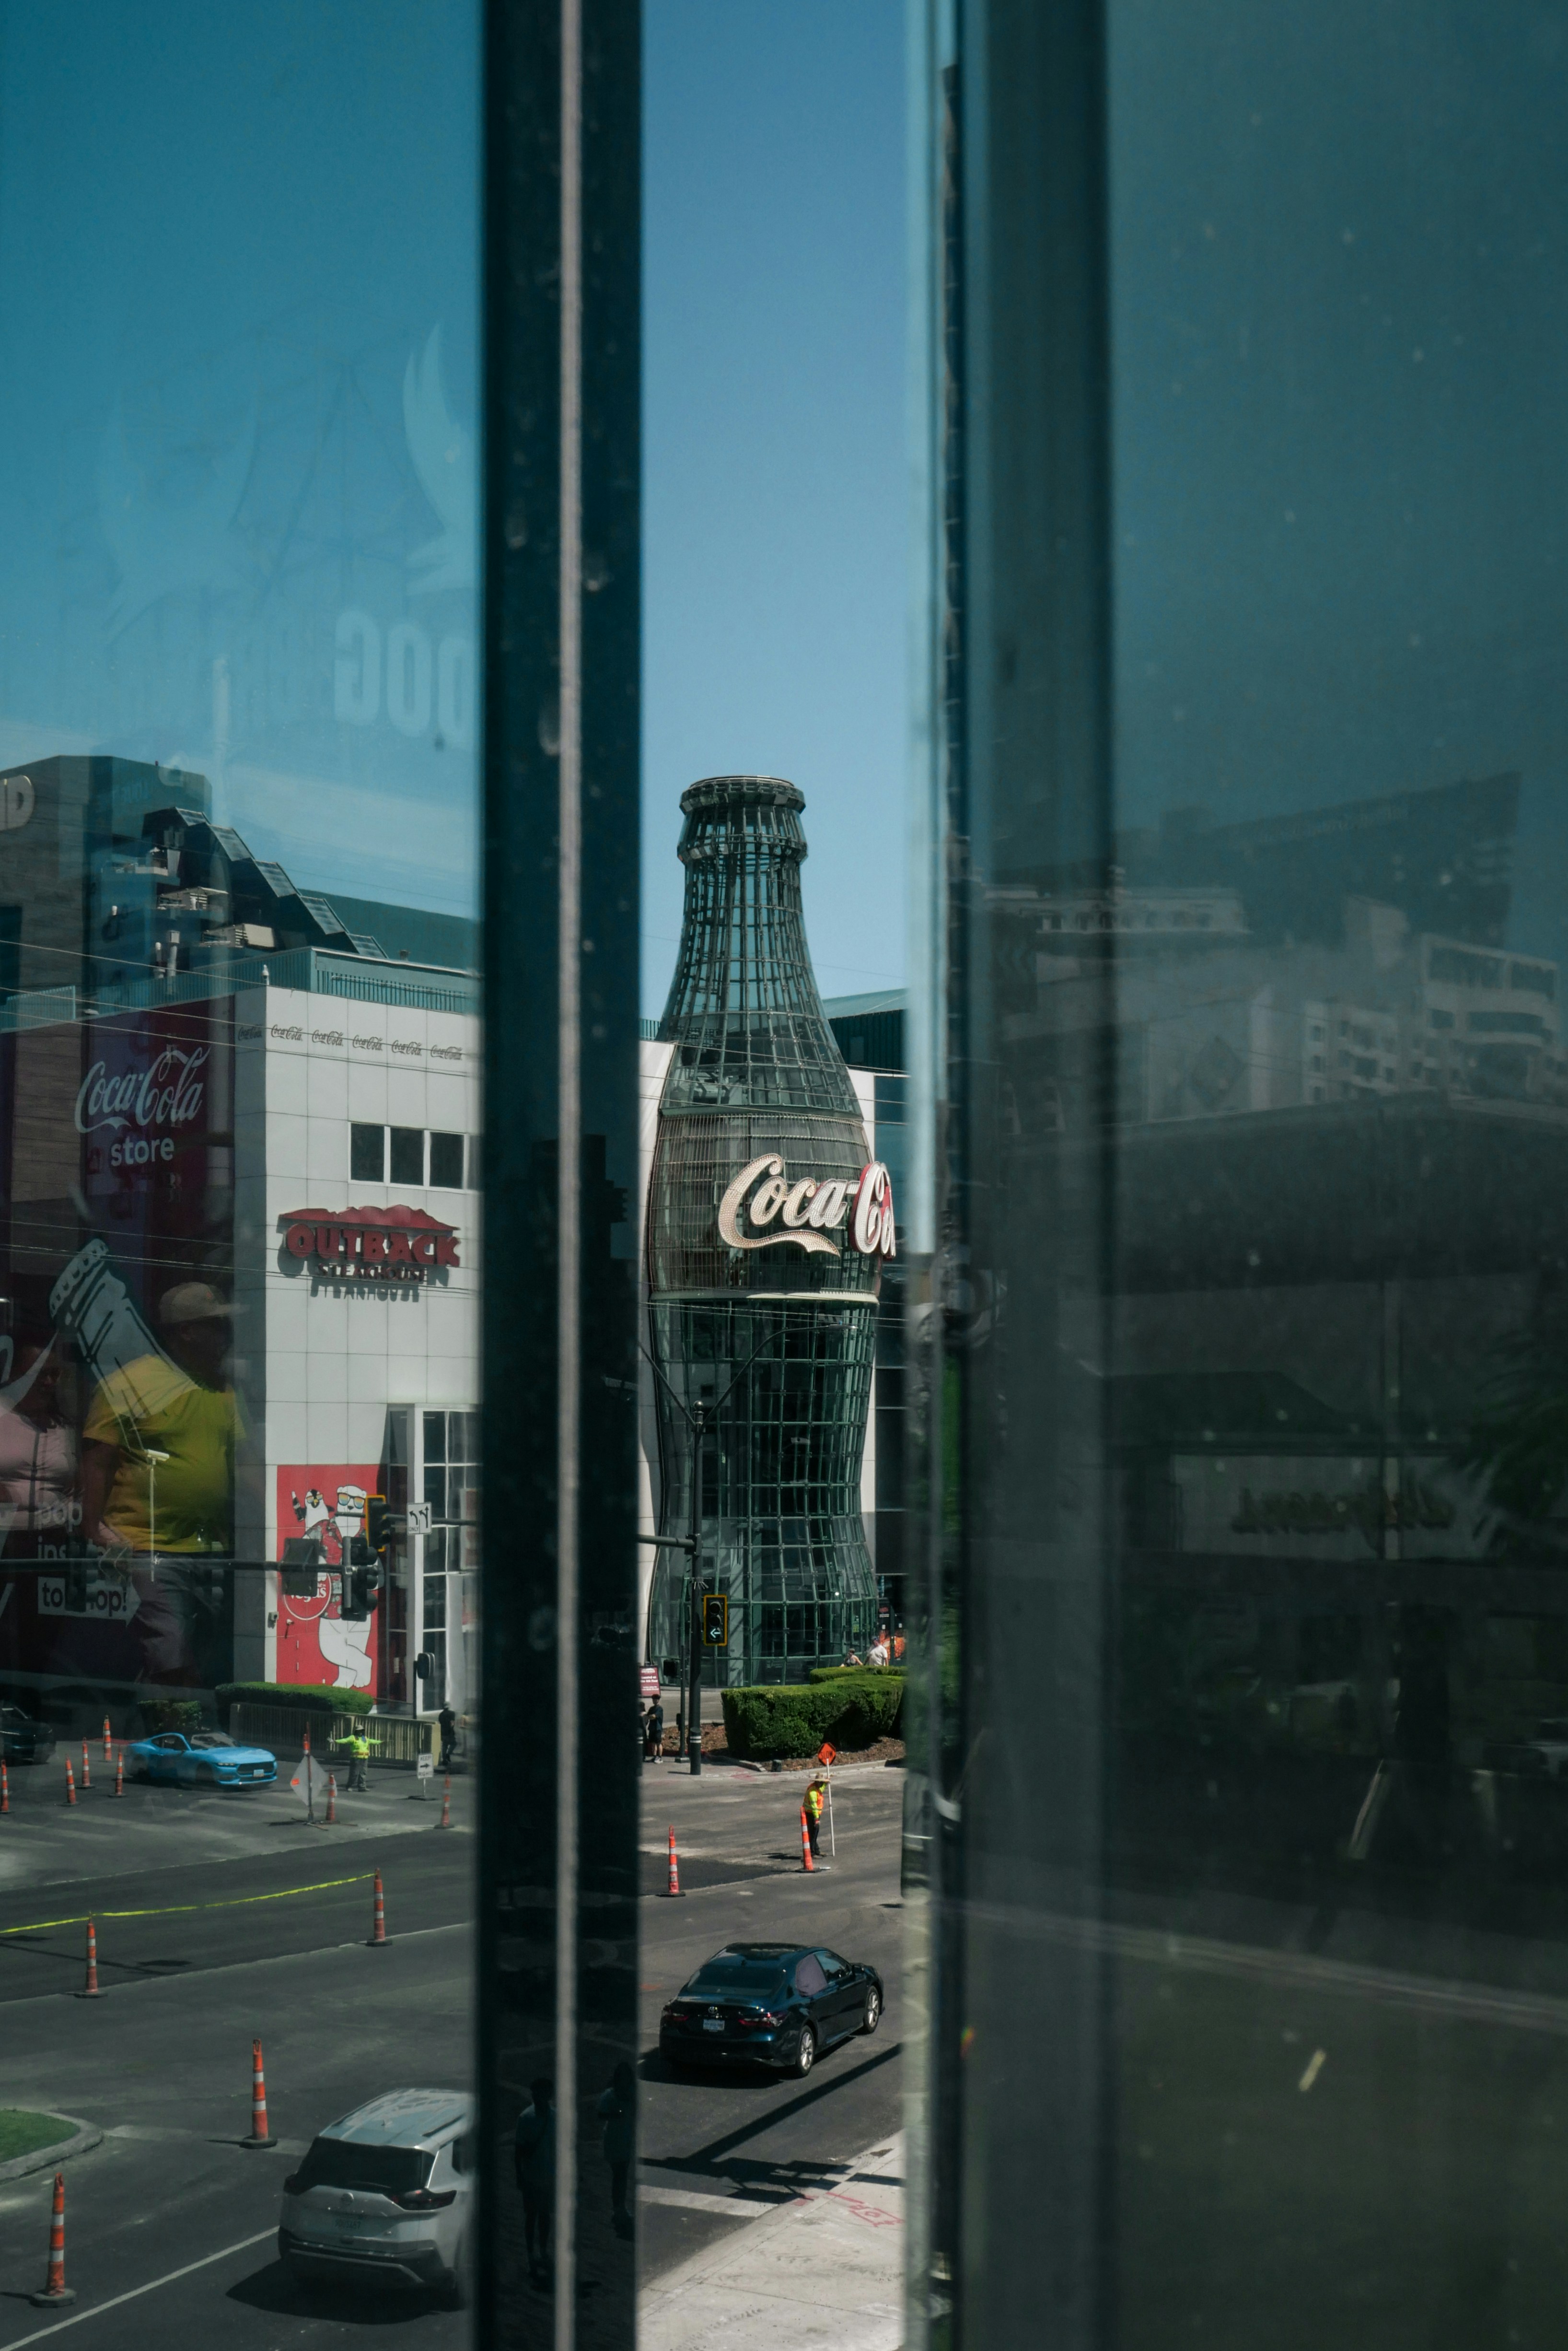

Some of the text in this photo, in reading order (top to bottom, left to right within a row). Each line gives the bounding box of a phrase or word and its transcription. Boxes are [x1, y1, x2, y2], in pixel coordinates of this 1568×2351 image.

[75, 1045, 211, 1133] Coca-Cola
[111, 1135, 174, 1166] store
[286, 1223, 461, 1267] OUTBACK
[318, 1263, 427, 1282] STEAKHOUSE
[38, 1502, 83, 1532] pop
[42, 1581, 63, 1607] to
[820, 1750, 833, 1760] SLOW
